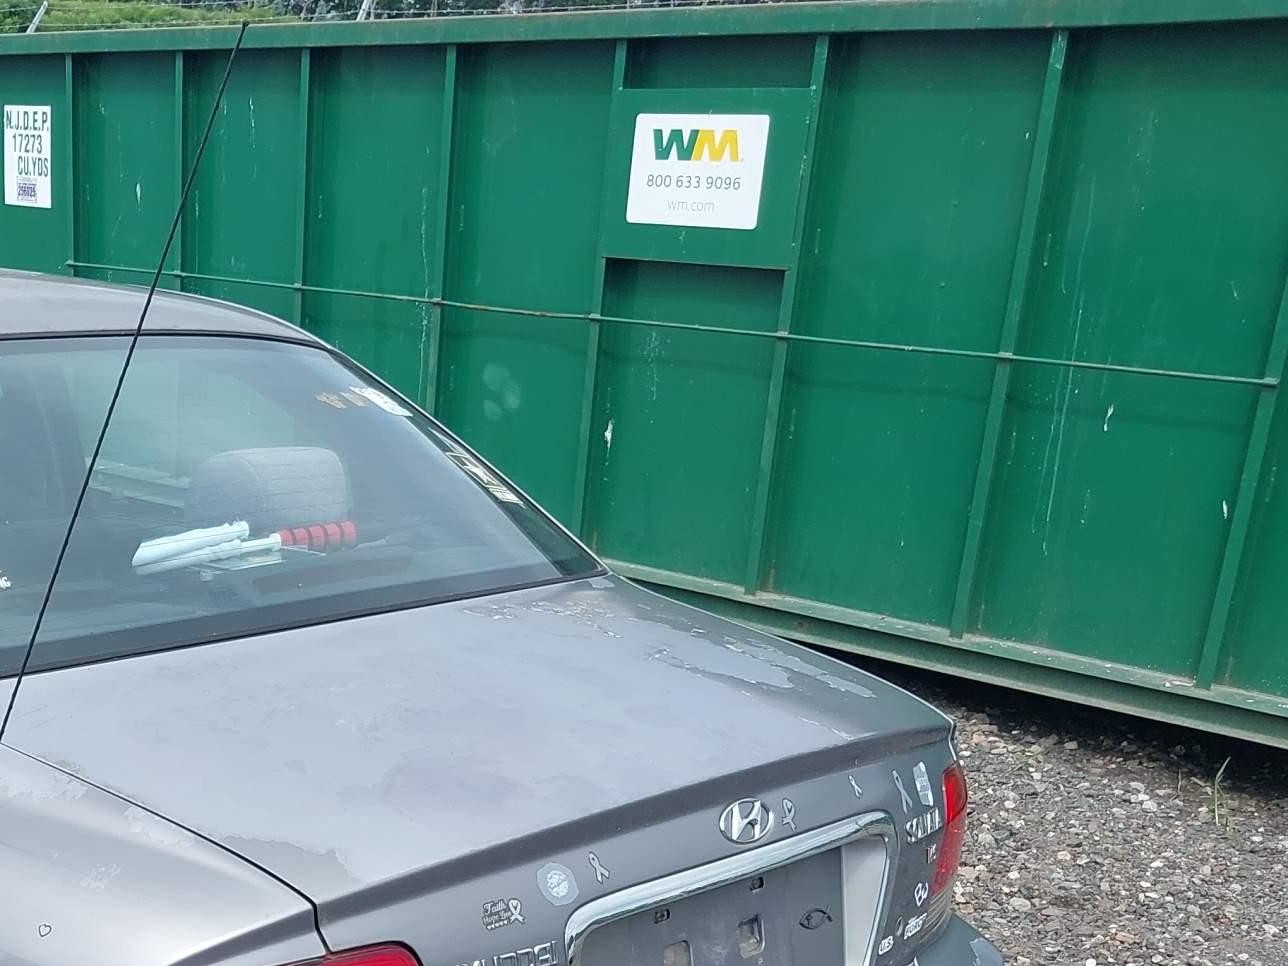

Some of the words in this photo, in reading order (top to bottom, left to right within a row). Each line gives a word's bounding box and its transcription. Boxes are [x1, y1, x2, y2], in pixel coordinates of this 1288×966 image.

[12, 133, 43, 154] 17273
[653, 128, 739, 161] WM
[646, 174, 672, 188] 800
[675, 175, 701, 189] 633
[705, 176, 742, 191] 9096
[667, 200, 715, 212] wm.com
